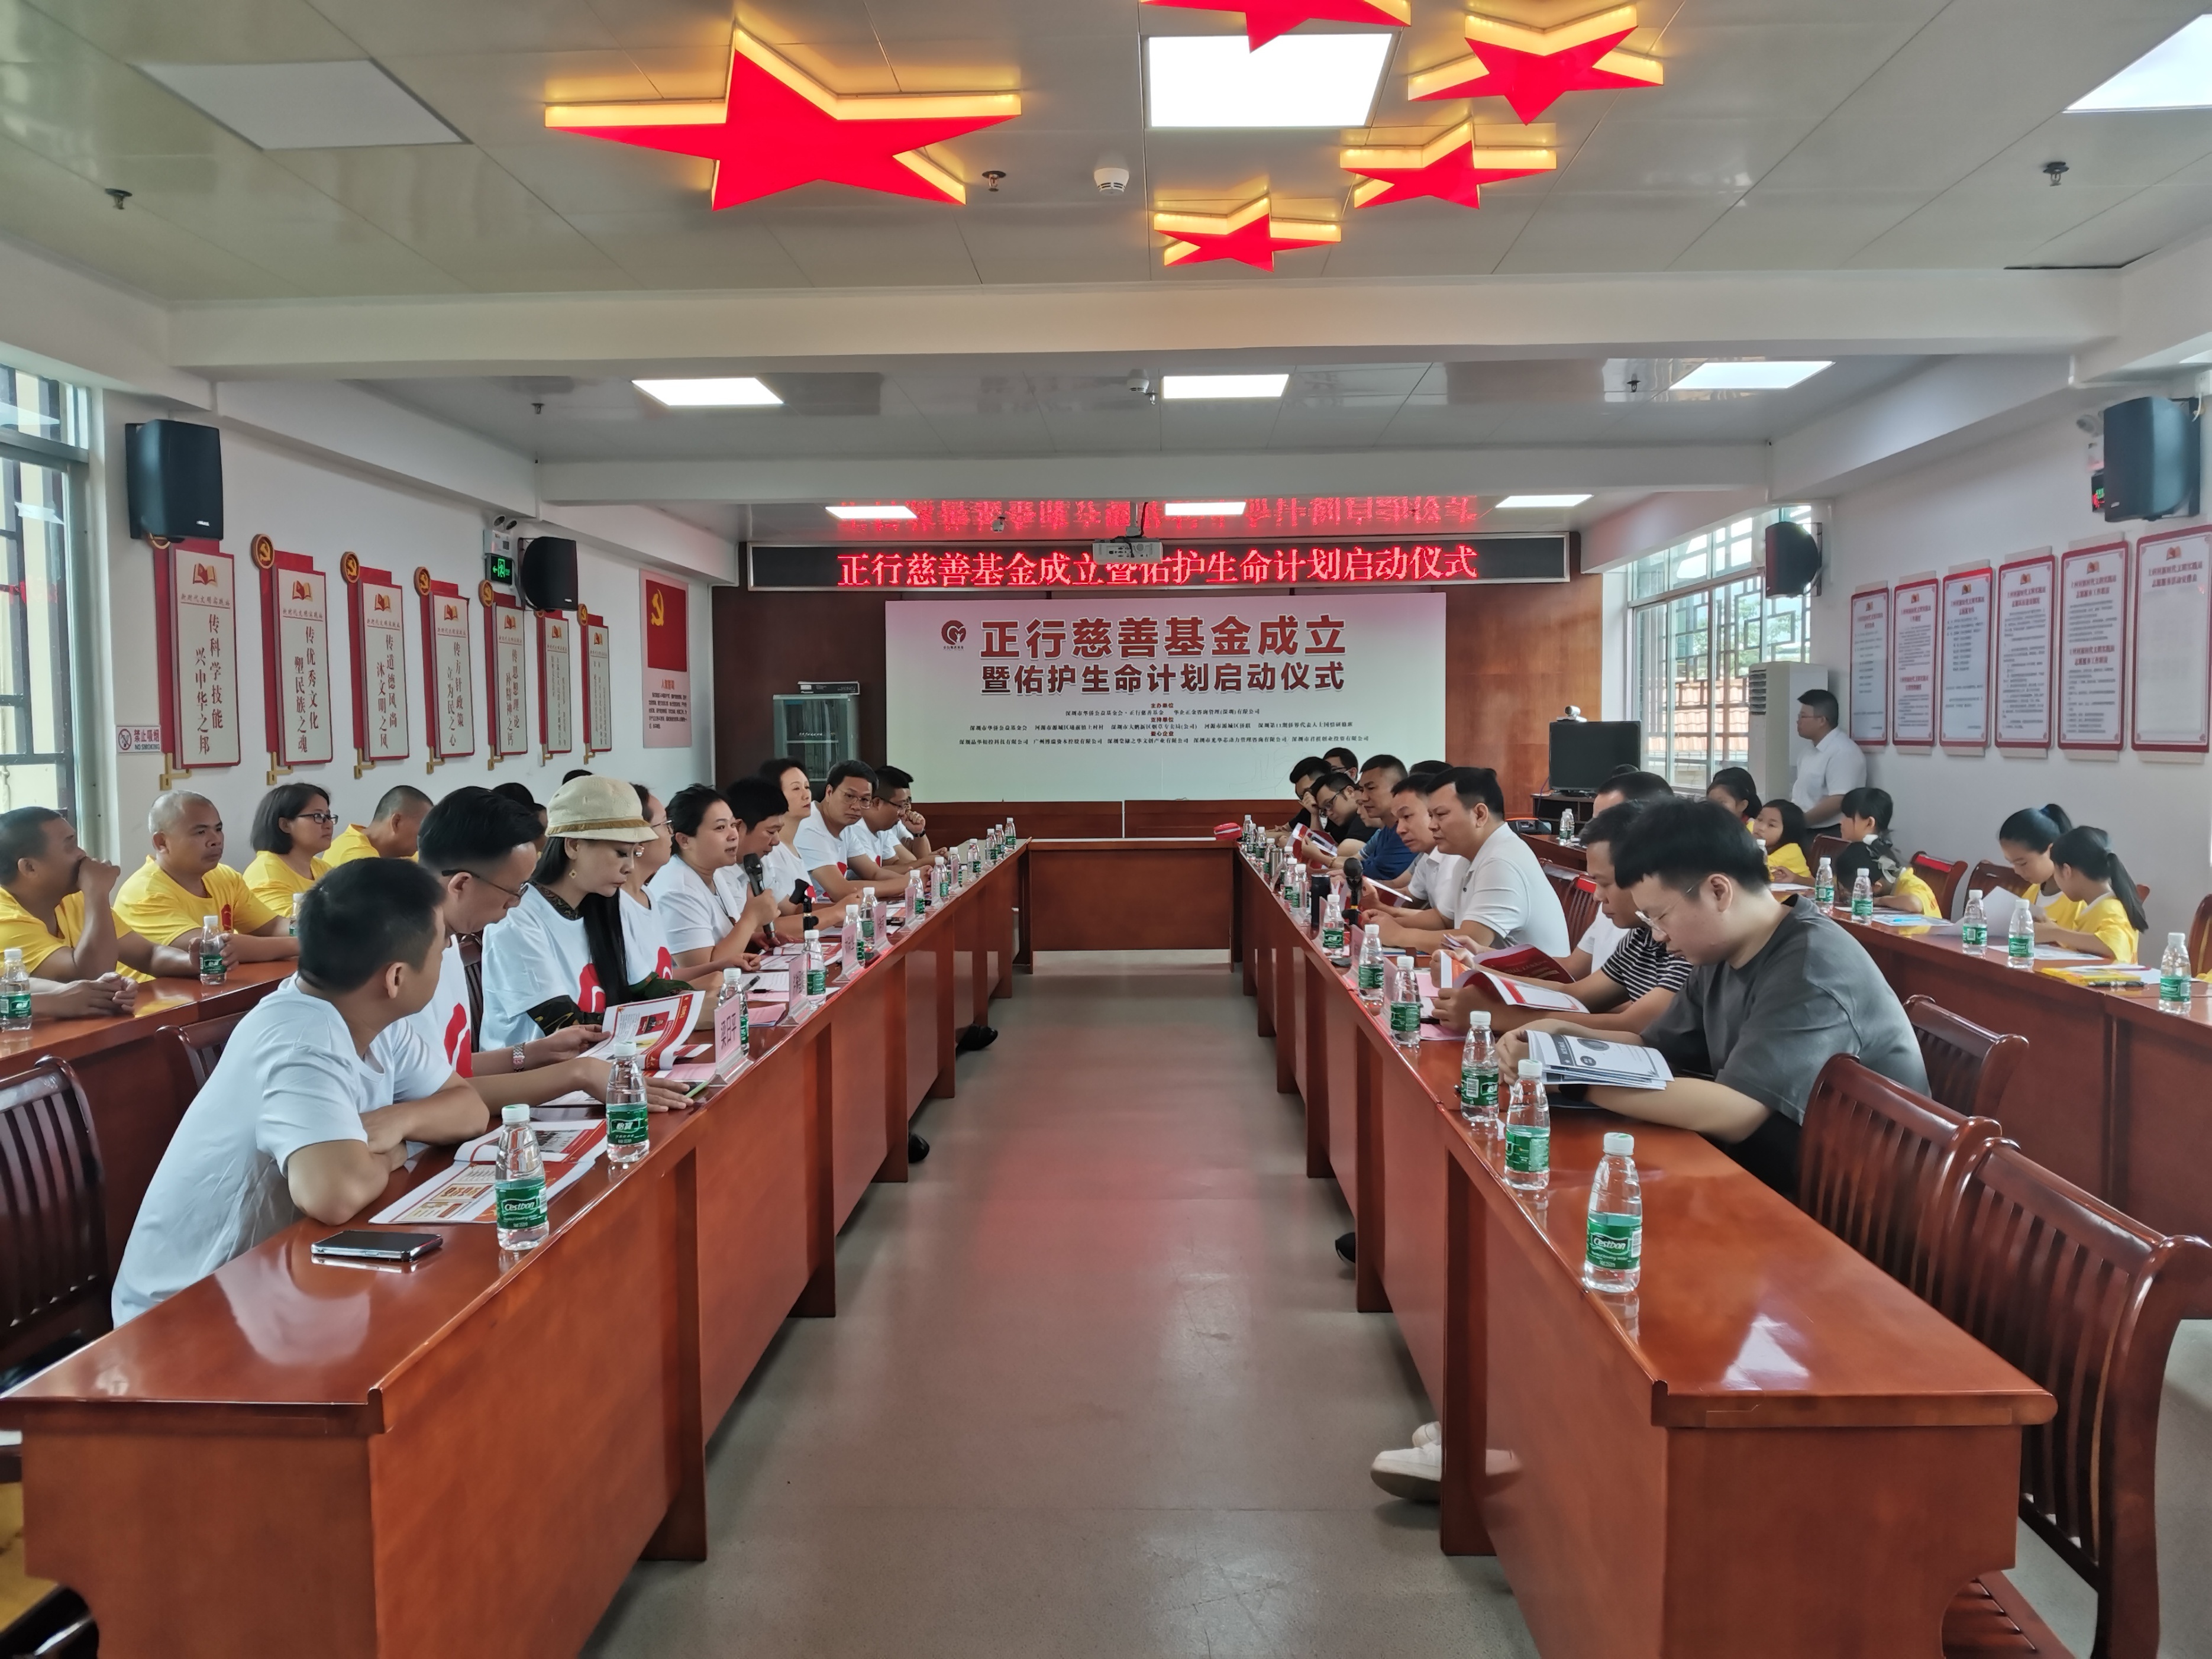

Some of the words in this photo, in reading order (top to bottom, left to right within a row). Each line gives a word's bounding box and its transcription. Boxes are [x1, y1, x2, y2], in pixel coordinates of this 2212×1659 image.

[208, 614, 224, 729] 传科学技能
[305, 626, 319, 730] 传优秀文化
[386, 634, 398, 728] 传道德风尚
[980, 614, 1346, 659] 正行慈善基金成立
[981, 661, 1345, 694] 暨佑护生命计划启动仪式
[195, 647, 210, 755] 兴中华之邦
[294, 656, 308, 753] 塑民族之魂
[376, 661, 389, 749] 沐文明之风
[453, 641, 464, 727] 传方针政策
[134, 729, 160, 743] 禁止吸烟
